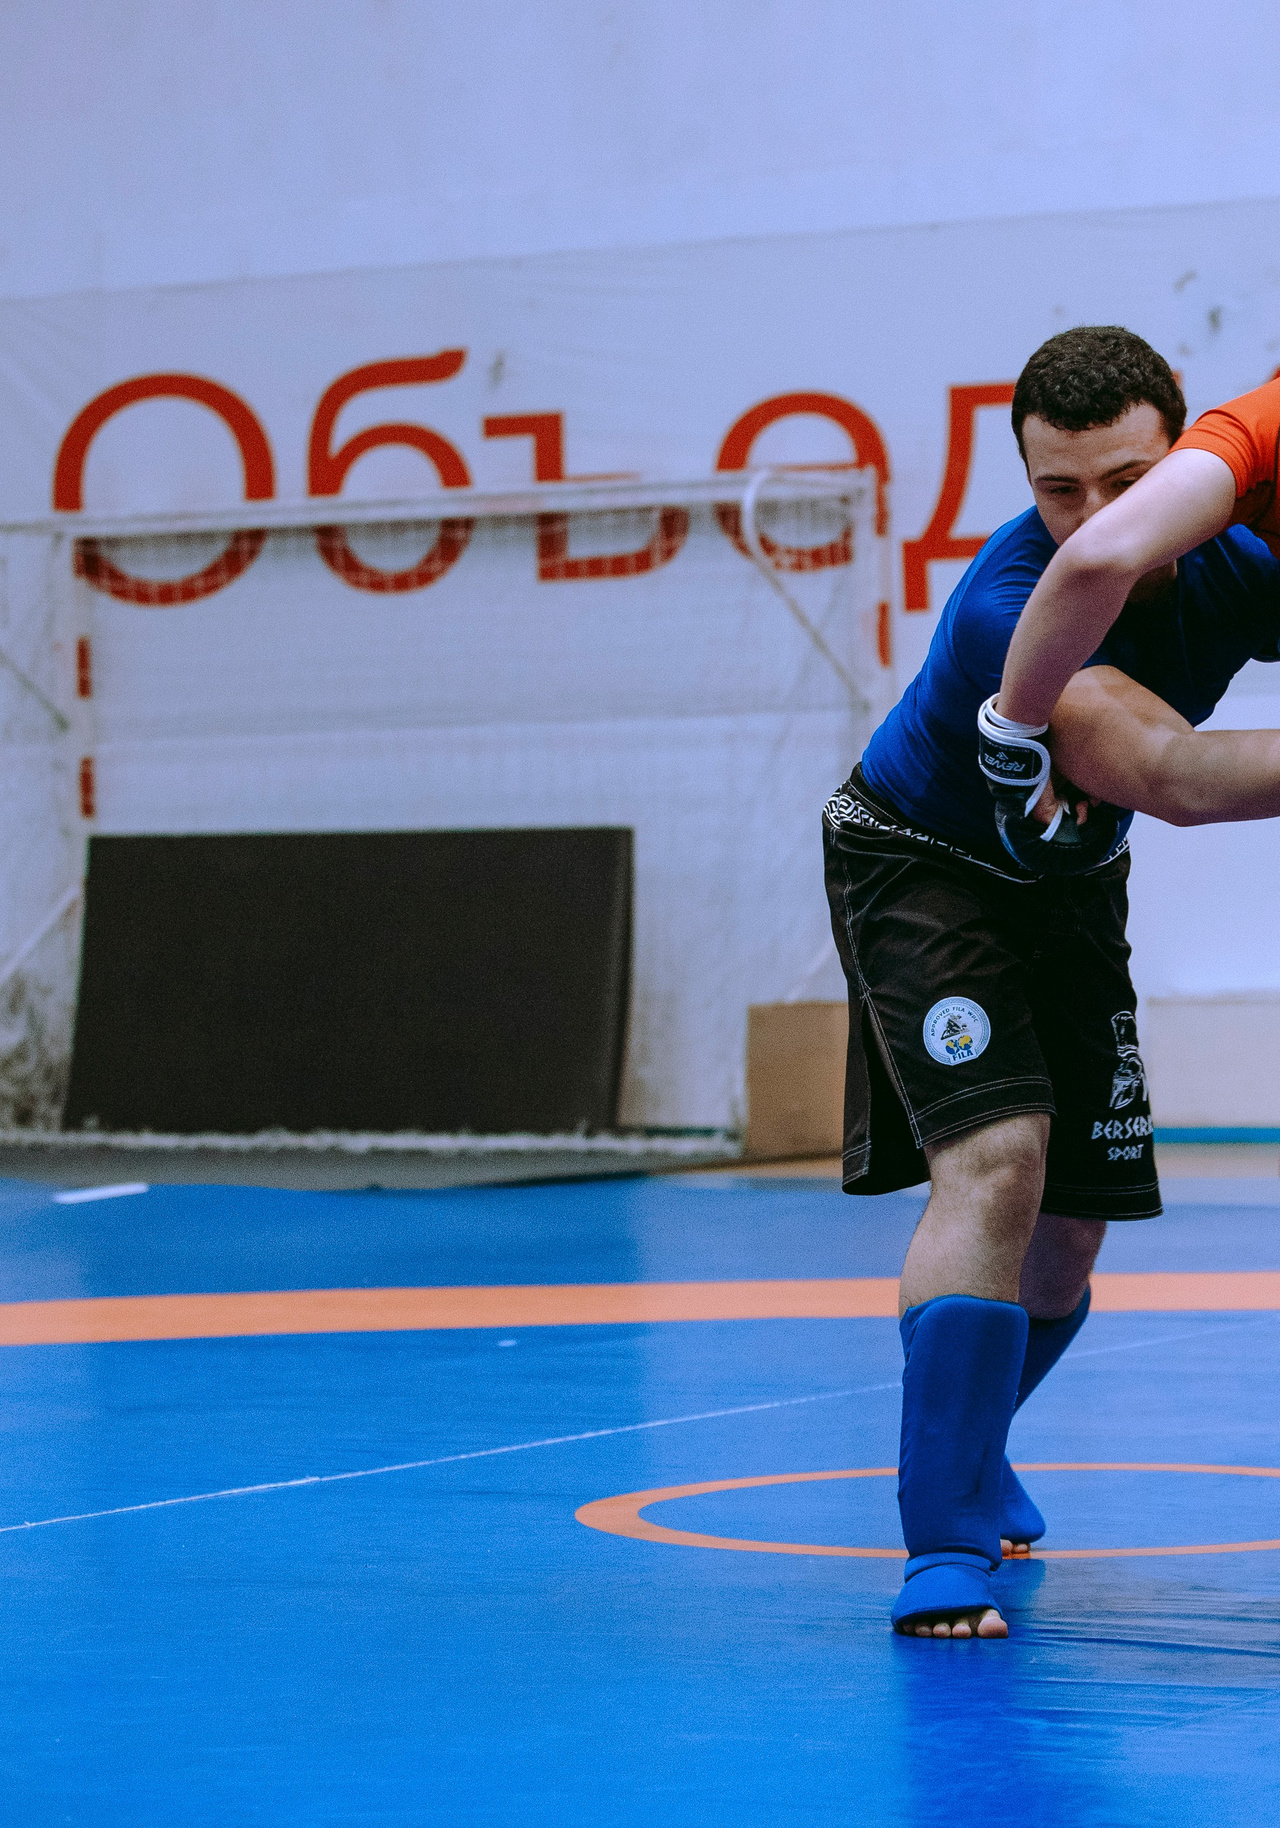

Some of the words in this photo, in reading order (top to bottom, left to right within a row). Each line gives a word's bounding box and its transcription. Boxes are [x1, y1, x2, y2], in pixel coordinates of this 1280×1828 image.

[930, 1008, 950, 1037] APPROVED
[952, 1050, 973, 1061] FILA
[1107, 1143, 1144, 1161] SPORT
